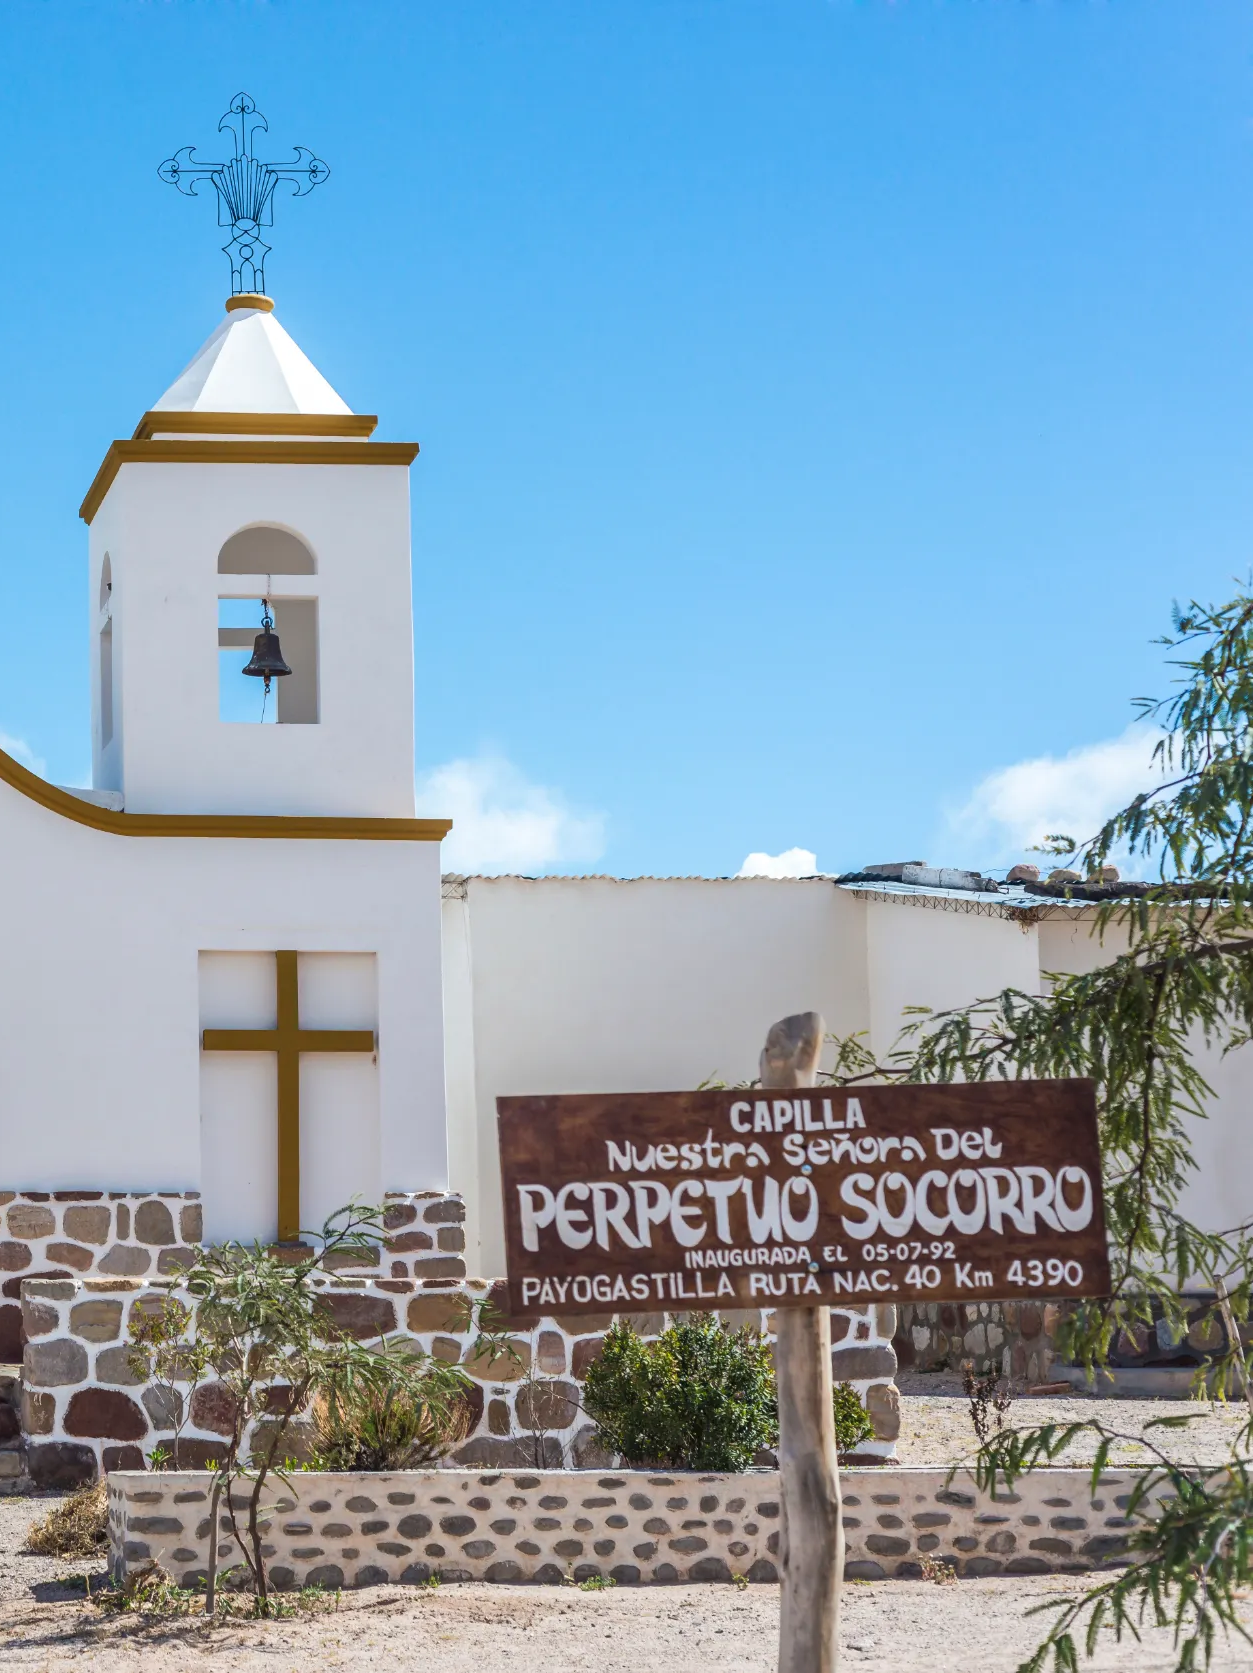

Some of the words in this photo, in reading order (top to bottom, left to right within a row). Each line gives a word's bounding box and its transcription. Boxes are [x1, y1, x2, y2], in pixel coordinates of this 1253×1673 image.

[730, 1097, 866, 1134] CAPILLA
[608, 1128, 769, 1172] Nuestra
[783, 1132, 926, 1166] Señora
[517, 1175, 819, 1252] PERPETUO
[840, 1165, 1094, 1240] SOCORRO
[685, 1245, 812, 1269] INAUGURADA
[823, 1245, 848, 1263] EL
[862, 1241, 956, 1262] 05-07-92
[522, 1270, 736, 1306] PAYOGASTILLA
[750, 1271, 822, 1298] RUTA
[833, 1268, 898, 1293] NAC.
[904, 1264, 942, 1290] 40
[955, 1265, 994, 1289] Km
[1007, 1259, 1084, 1287] 4390
